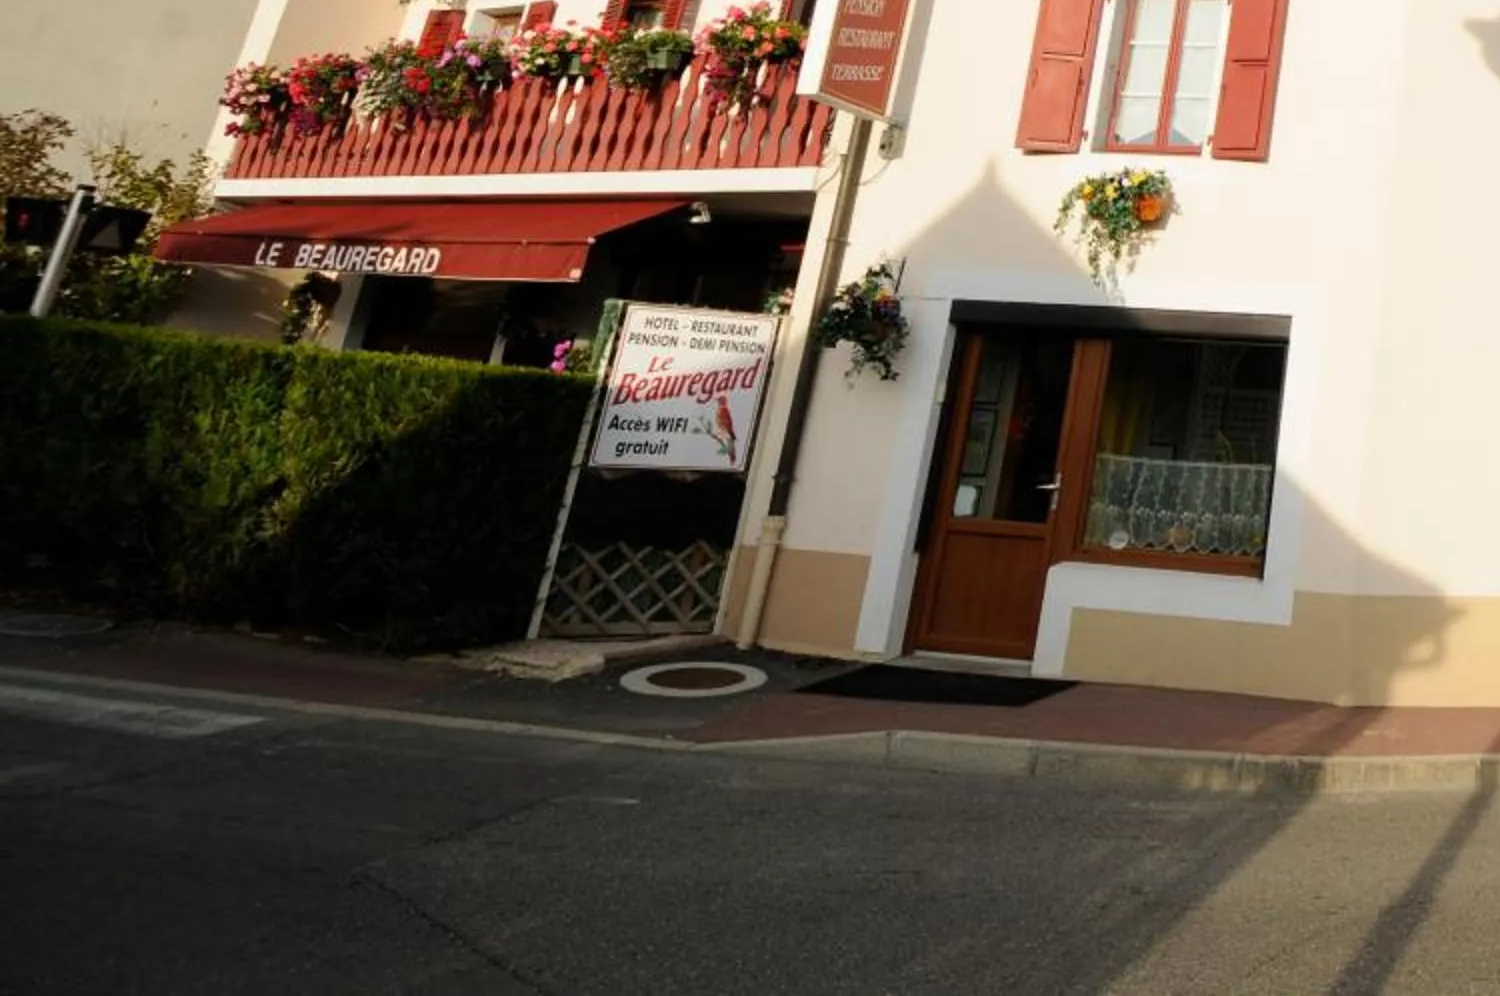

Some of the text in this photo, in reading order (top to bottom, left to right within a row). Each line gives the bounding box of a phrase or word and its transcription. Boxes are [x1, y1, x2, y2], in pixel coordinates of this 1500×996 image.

[836, 27, 896, 50] RESTAURANT
[831, 63, 885, 83] TERRASSE
[254, 243, 441, 273] LE BEAUREGARD
[645, 316, 680, 331] HOTEL
[690, 321, 759, 337] RESTAURANT
[628, 332, 679, 347] PENSION
[689, 336, 716, 351] DEMI
[718, 340, 766, 354] PENSION
[646, 355, 675, 374] Le
[611, 357, 762, 406] Beauregard
[655, 416, 690, 434] WIFI
[615, 439, 669, 457] gratuit
